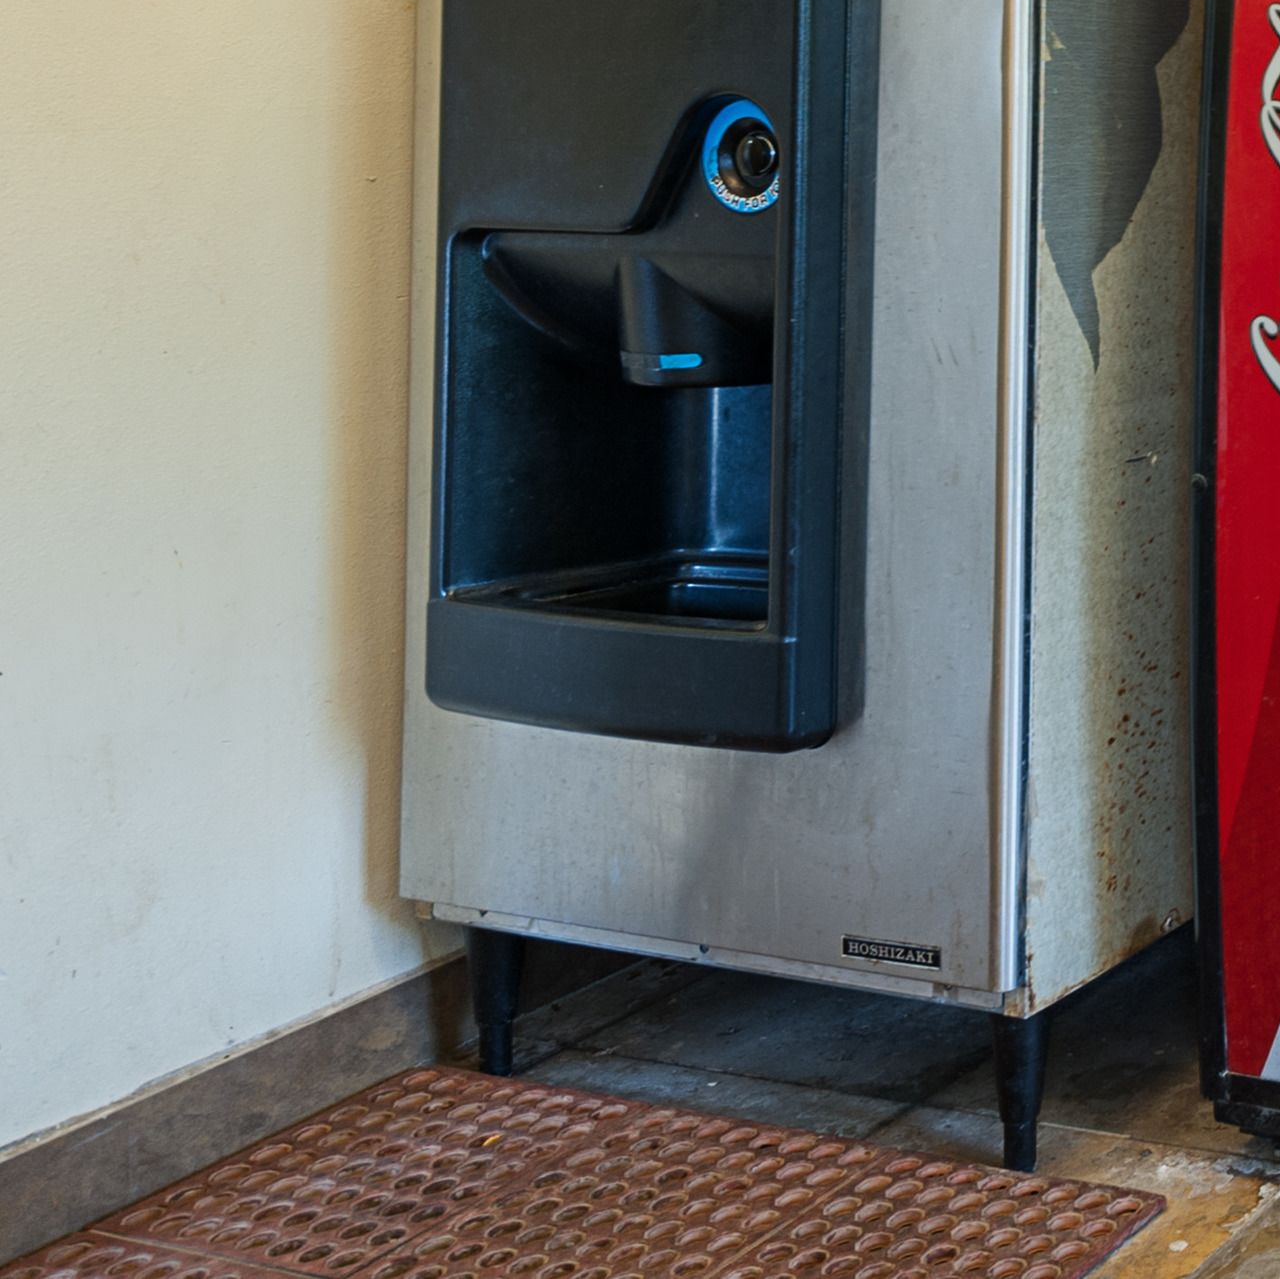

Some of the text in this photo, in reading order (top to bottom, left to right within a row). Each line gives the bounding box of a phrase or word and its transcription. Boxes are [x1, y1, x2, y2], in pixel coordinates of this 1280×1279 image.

[711, 176, 739, 206] PUSH
[745, 194, 767, 209] FOR
[848, 941, 934, 963] HOSHIZAKI
